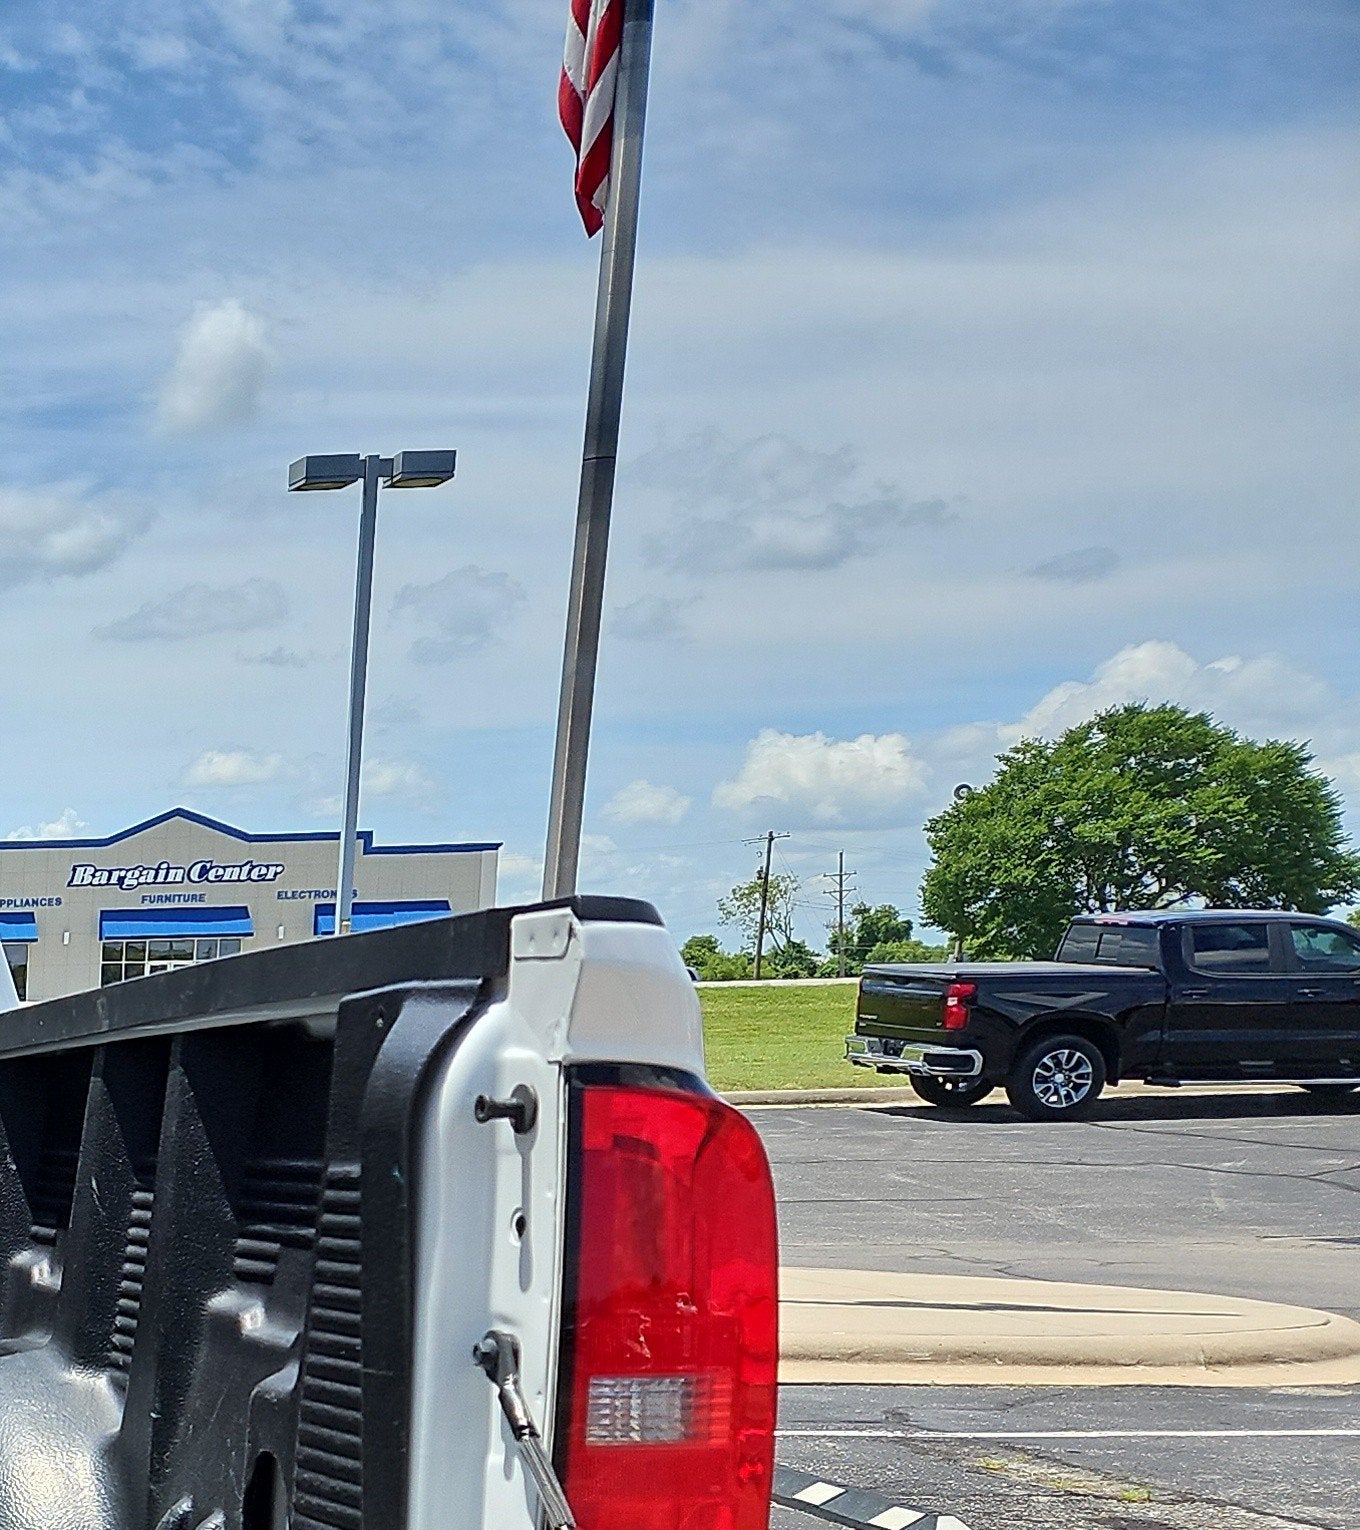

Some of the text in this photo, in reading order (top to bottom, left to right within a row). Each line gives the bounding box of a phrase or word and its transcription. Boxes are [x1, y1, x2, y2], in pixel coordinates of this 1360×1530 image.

[68, 860, 283, 889] Bargain Center
[141, 893, 206, 904] FURNITURE
[277, 889, 358, 900] ELECTRONS
